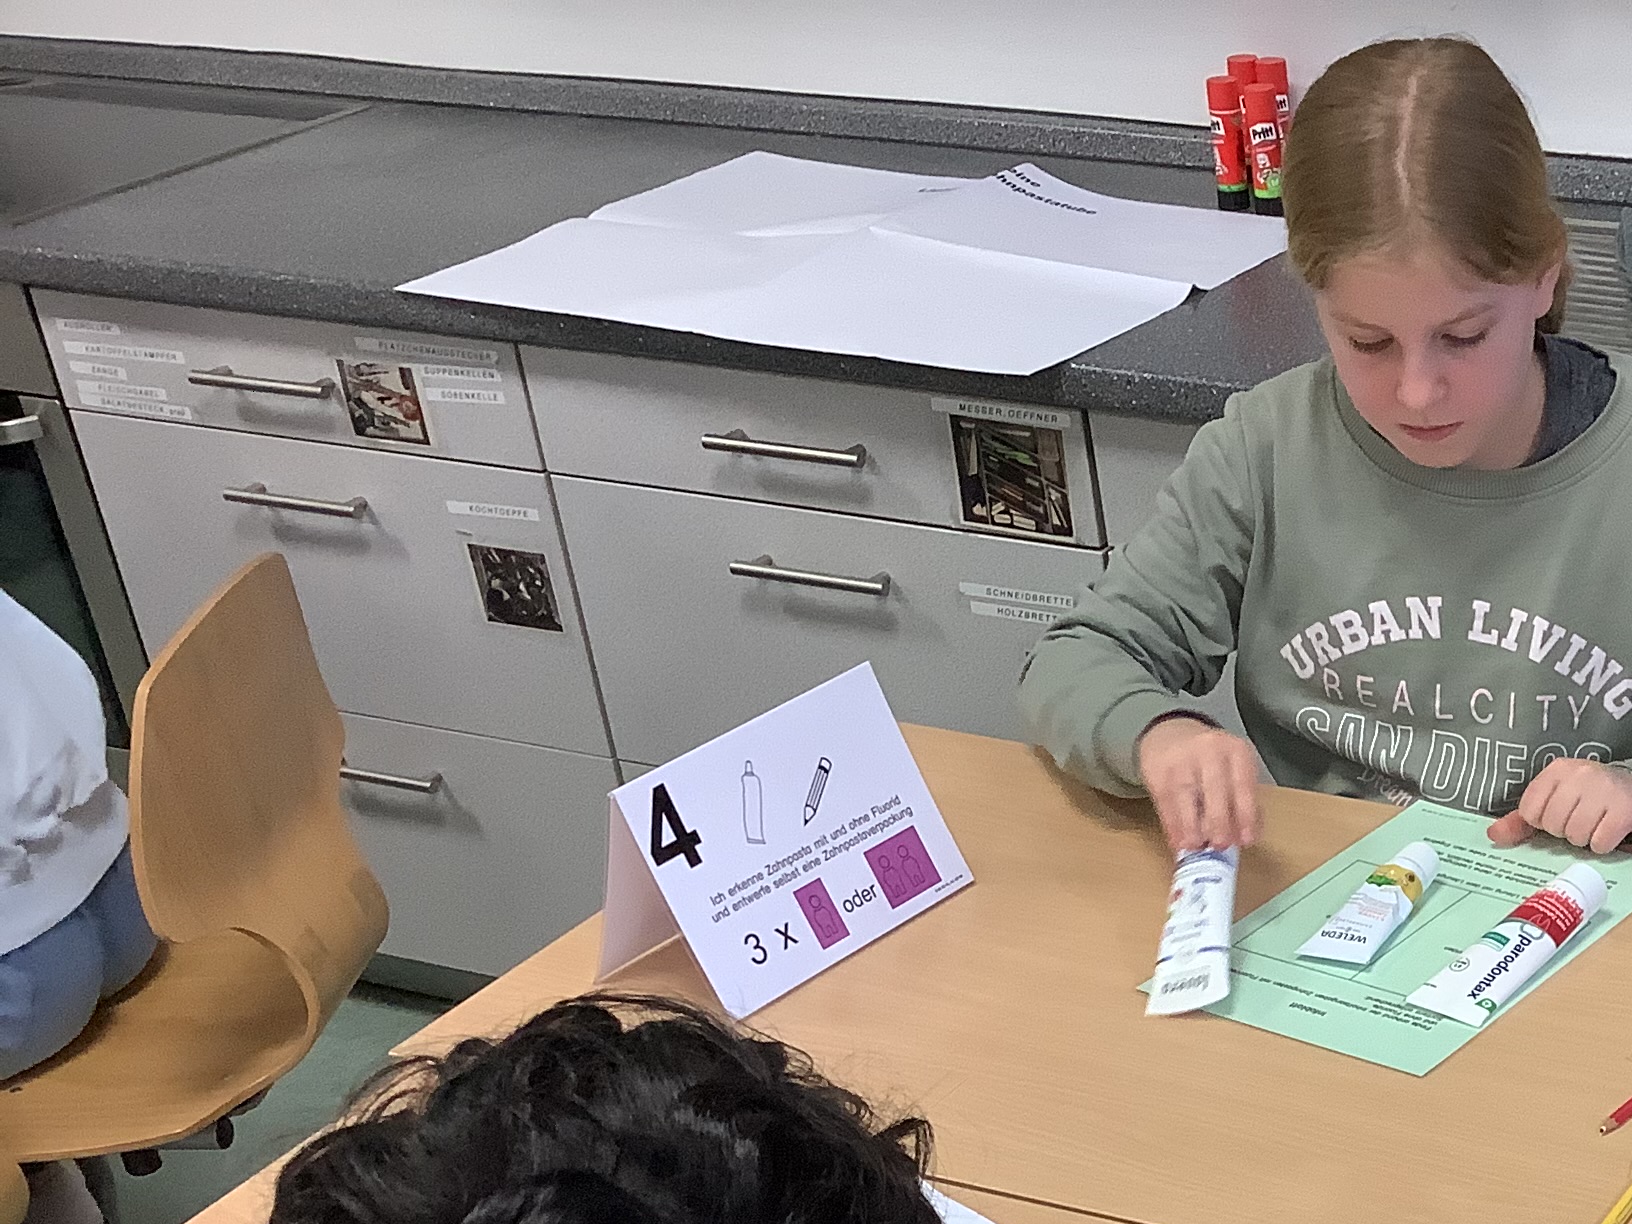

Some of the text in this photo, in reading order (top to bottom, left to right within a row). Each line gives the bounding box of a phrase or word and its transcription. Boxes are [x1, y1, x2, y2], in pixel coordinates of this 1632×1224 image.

[1252, 126, 1273, 140] Pritt
[996, 174, 1097, 214] hnpastatube
[986, 588, 1073, 606] SCHNEIDBRETTE
[1279, 596, 1443, 681] URBAN
[650, 783, 703, 868] 4
[709, 795, 901, 906] Ich erkenne Zahnpasta mit und ohne Fluorid
[711, 806, 914, 923] und entwerfe selbst eine Zahnpastaverpackung
[744, 884, 878, 965] 3 x oder
[1321, 929, 1367, 944] WELEDA
[1466, 934, 1532, 1001] parodontax
